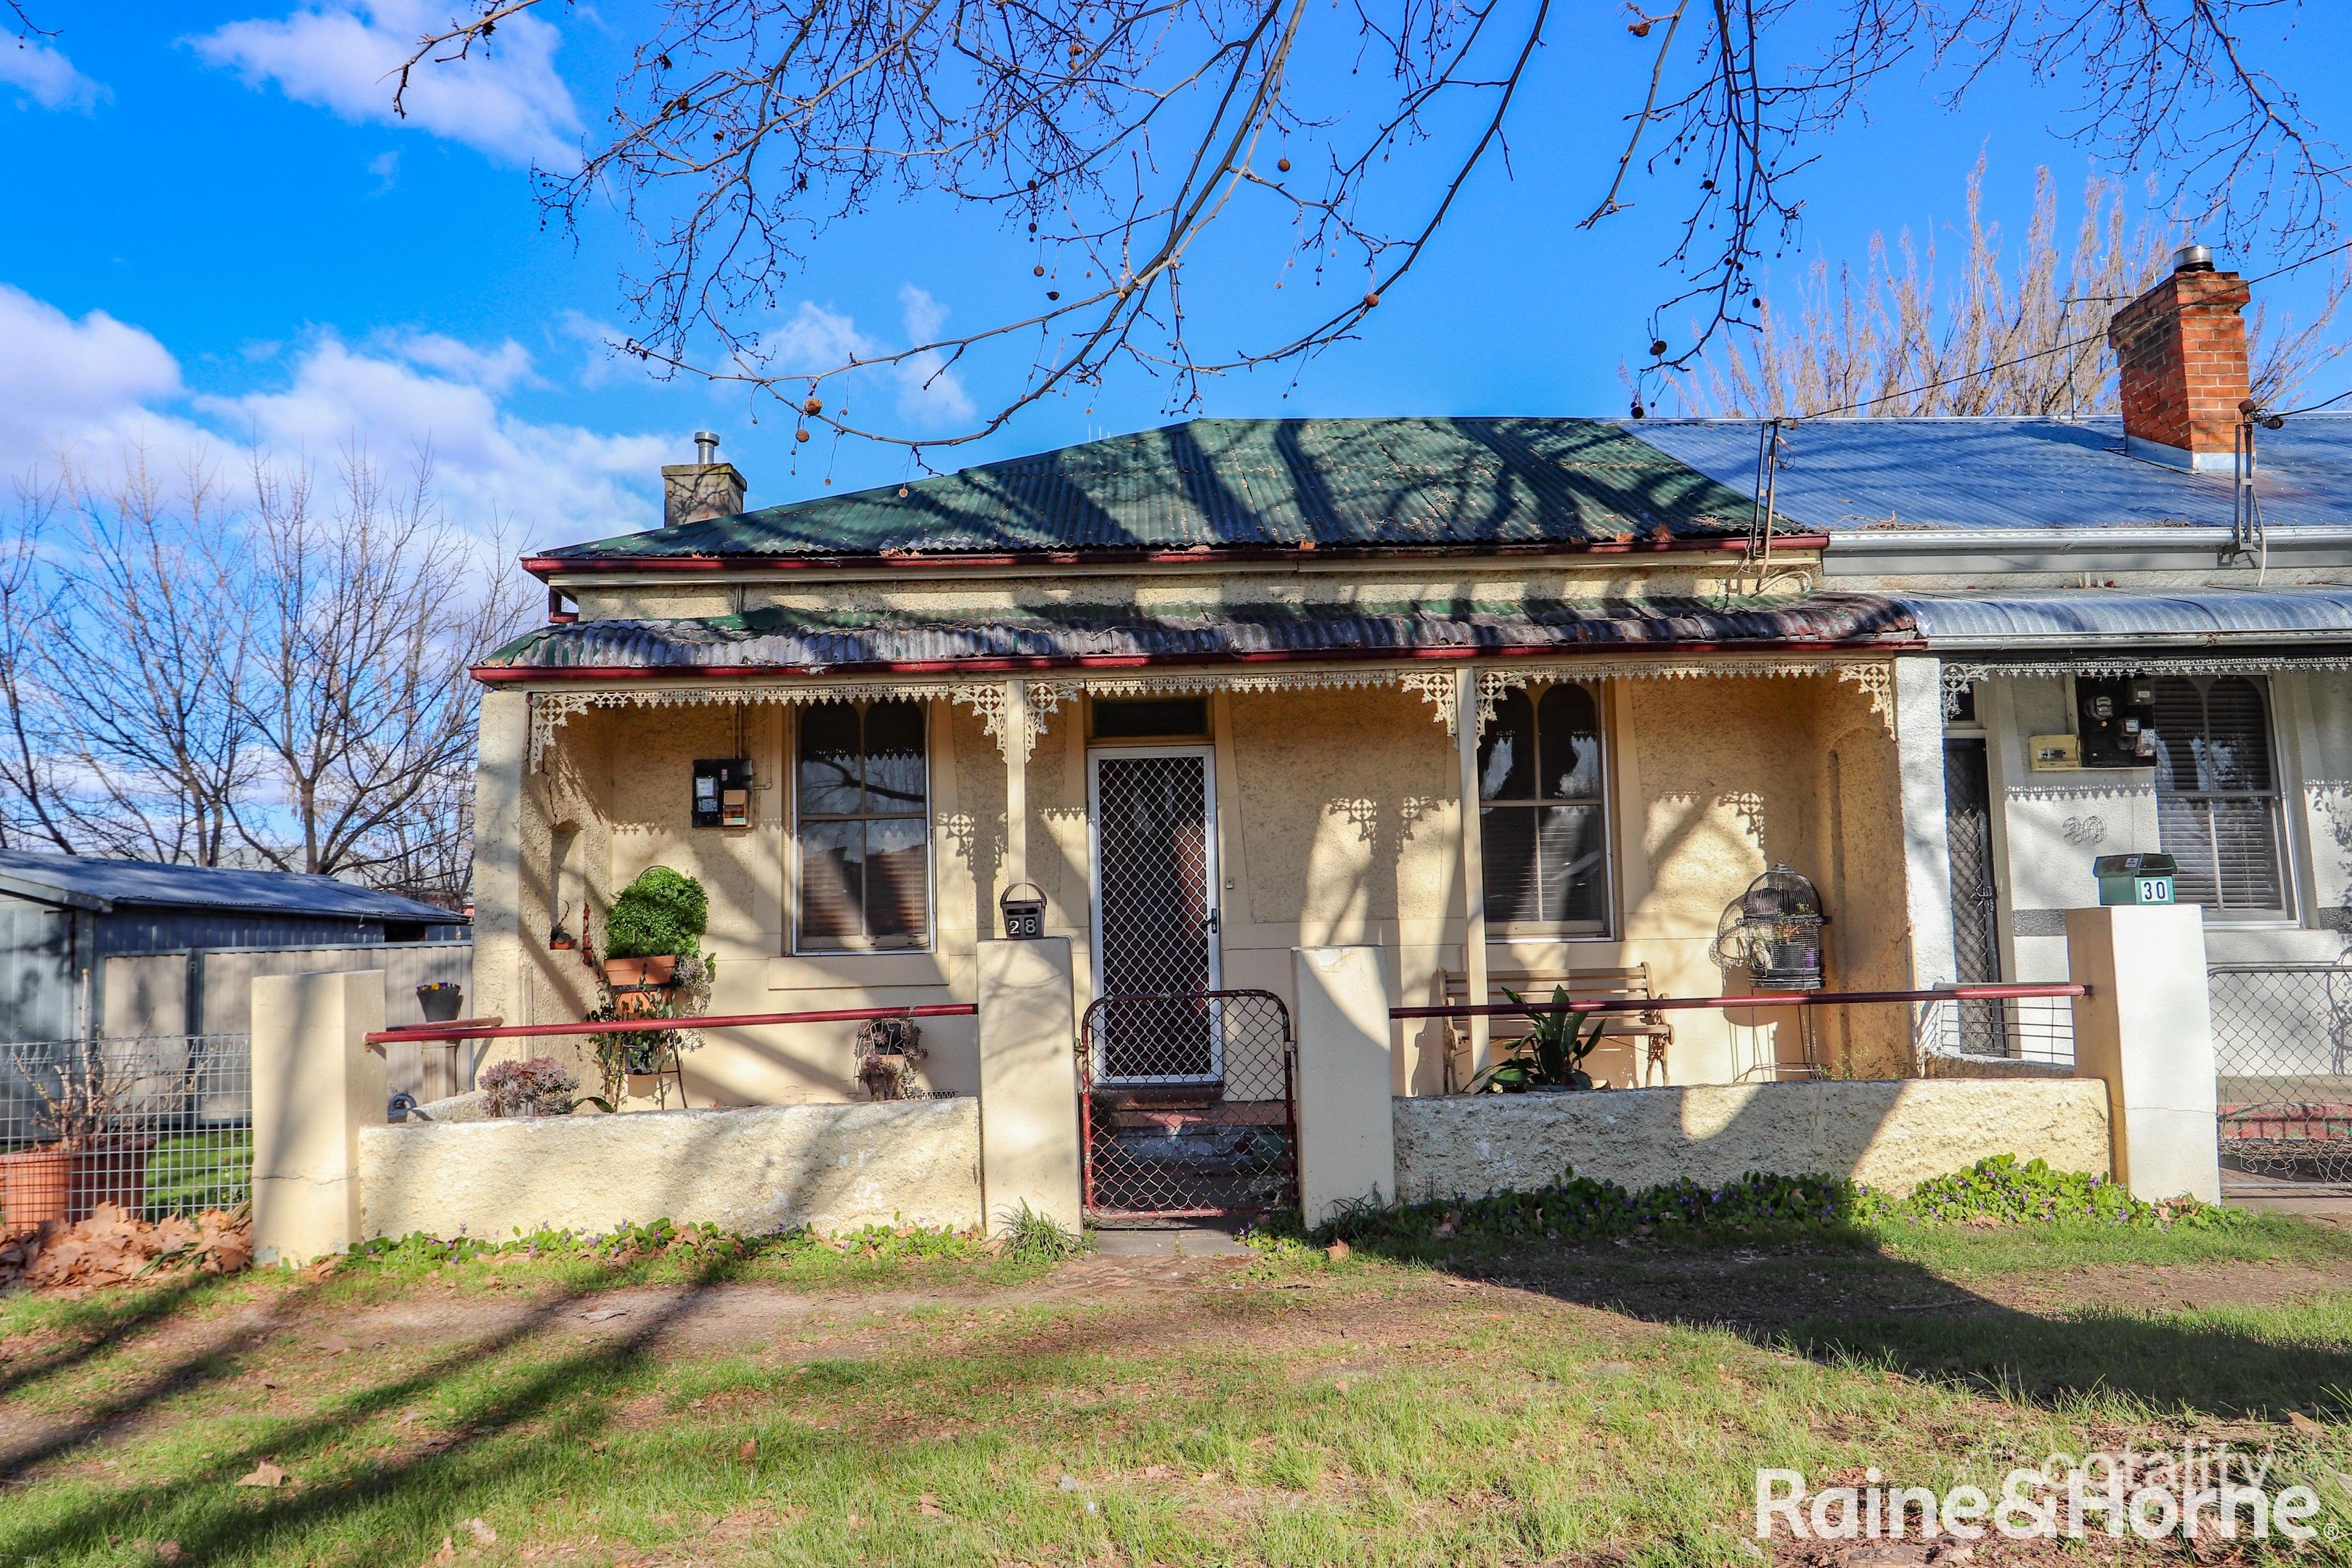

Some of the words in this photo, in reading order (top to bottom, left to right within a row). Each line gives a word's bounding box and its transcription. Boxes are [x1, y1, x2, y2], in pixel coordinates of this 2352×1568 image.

[2062, 815, 2107, 846] 30
[2144, 881, 2165, 900] 30
[1008, 919, 1037, 934] 28
